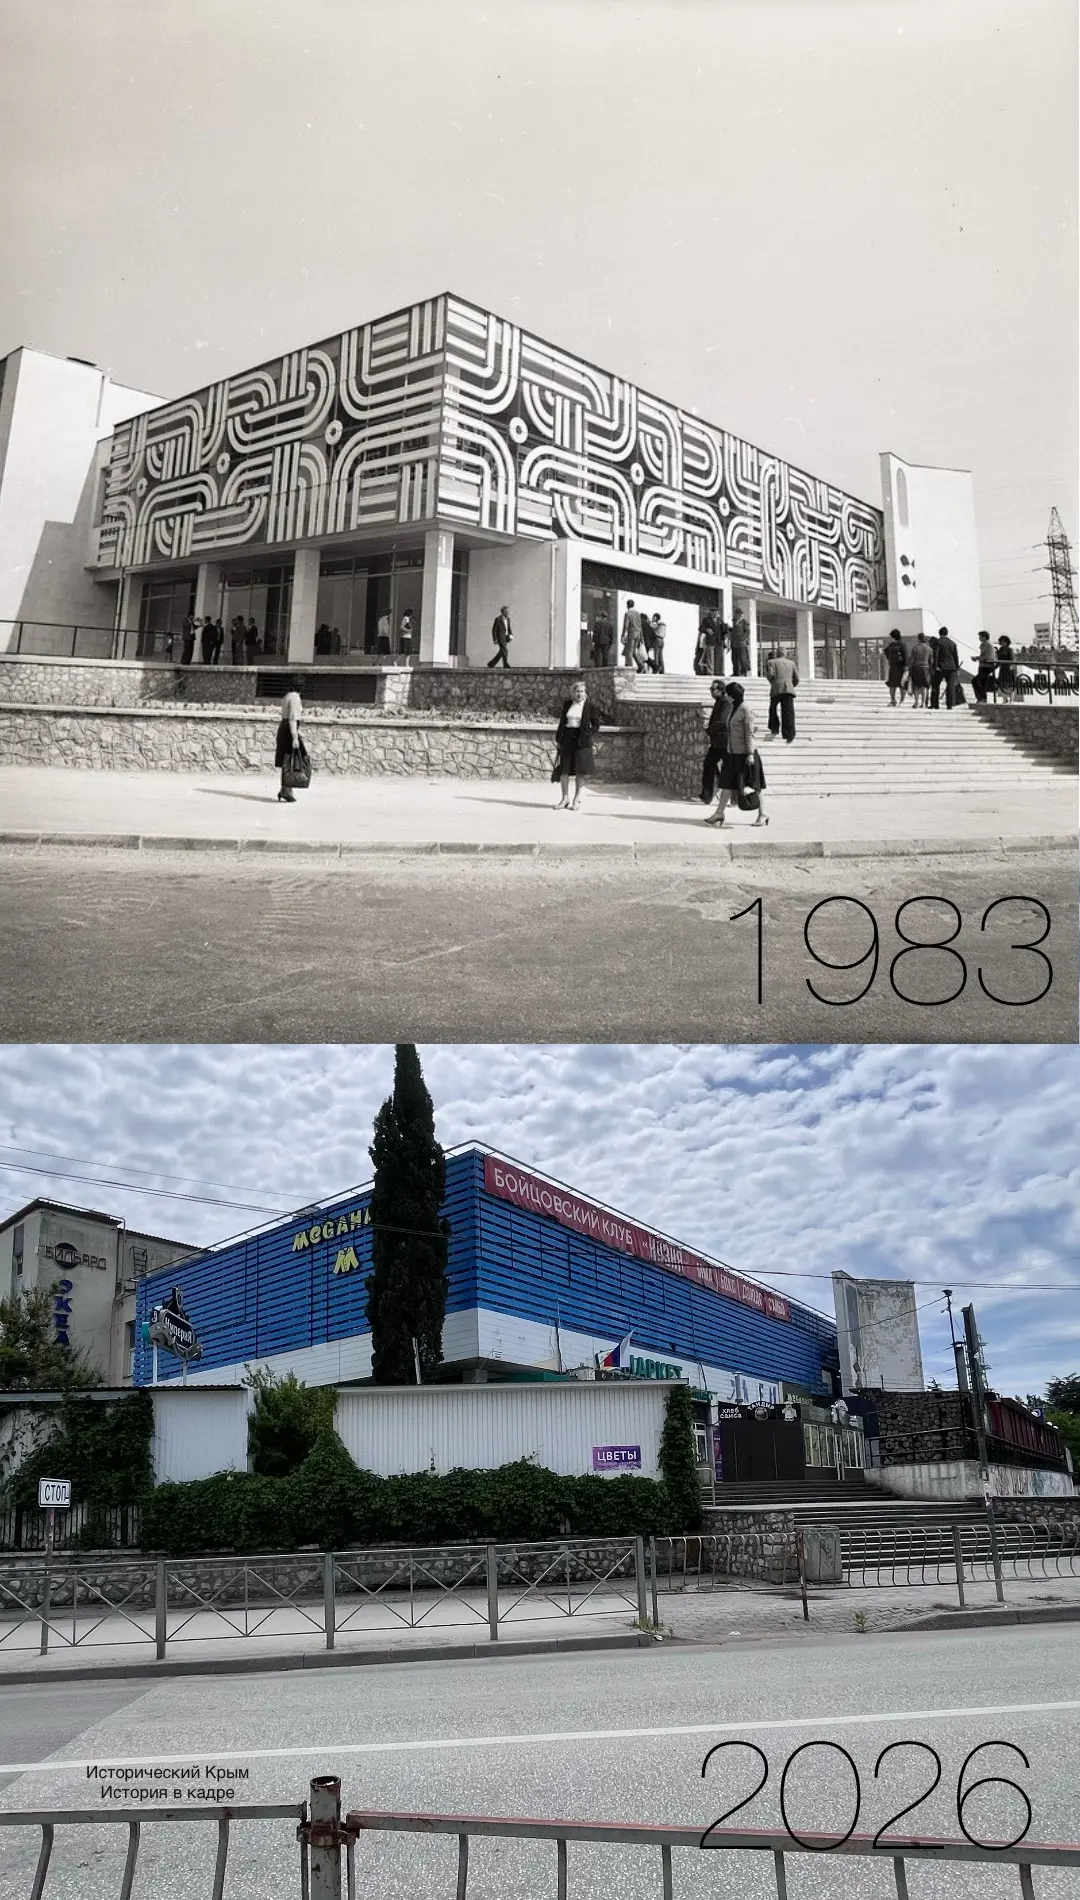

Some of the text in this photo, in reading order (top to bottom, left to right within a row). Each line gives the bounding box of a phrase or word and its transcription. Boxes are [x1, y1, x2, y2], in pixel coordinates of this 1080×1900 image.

[494, 1167, 601, 1229] БОЙЦОВСКИЙ
[602, 1219, 633, 1245] КЛУБ
[597, 1450, 637, 1462] ЦВЕТЫ
[44, 1484, 67, 1502] СТОП
